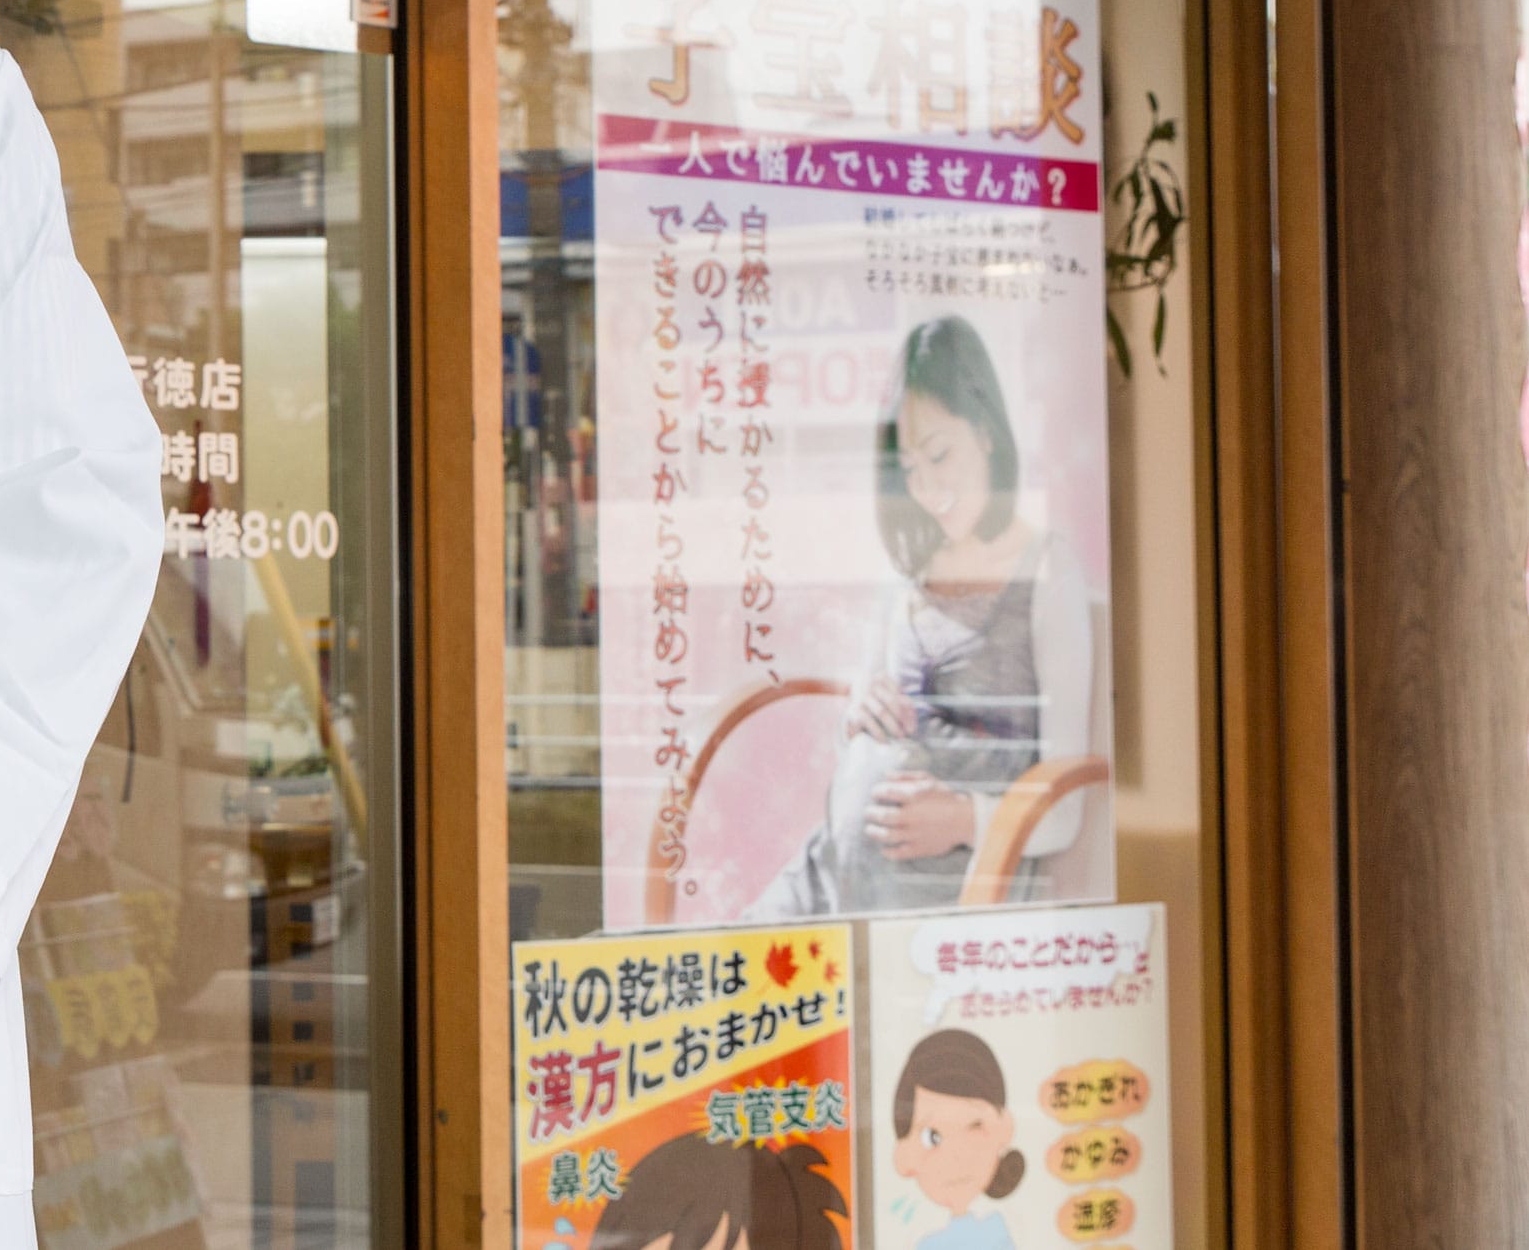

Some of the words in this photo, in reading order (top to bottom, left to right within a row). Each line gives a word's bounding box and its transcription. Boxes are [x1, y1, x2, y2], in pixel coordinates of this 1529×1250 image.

[639, 132, 1068, 206] 一人で悩んでいませんか?
[692, 200, 727, 455] 今のうちに
[162, 429, 240, 484] 時間
[166, 506, 339, 560] 午後8:00
[647, 205, 698, 896] できることから始めてみよう。
[523, 951, 749, 1038] 秋の乾燥は
[706, 1082, 847, 1142] 気管支炎
[549, 1150, 622, 1203] 鼻炎
